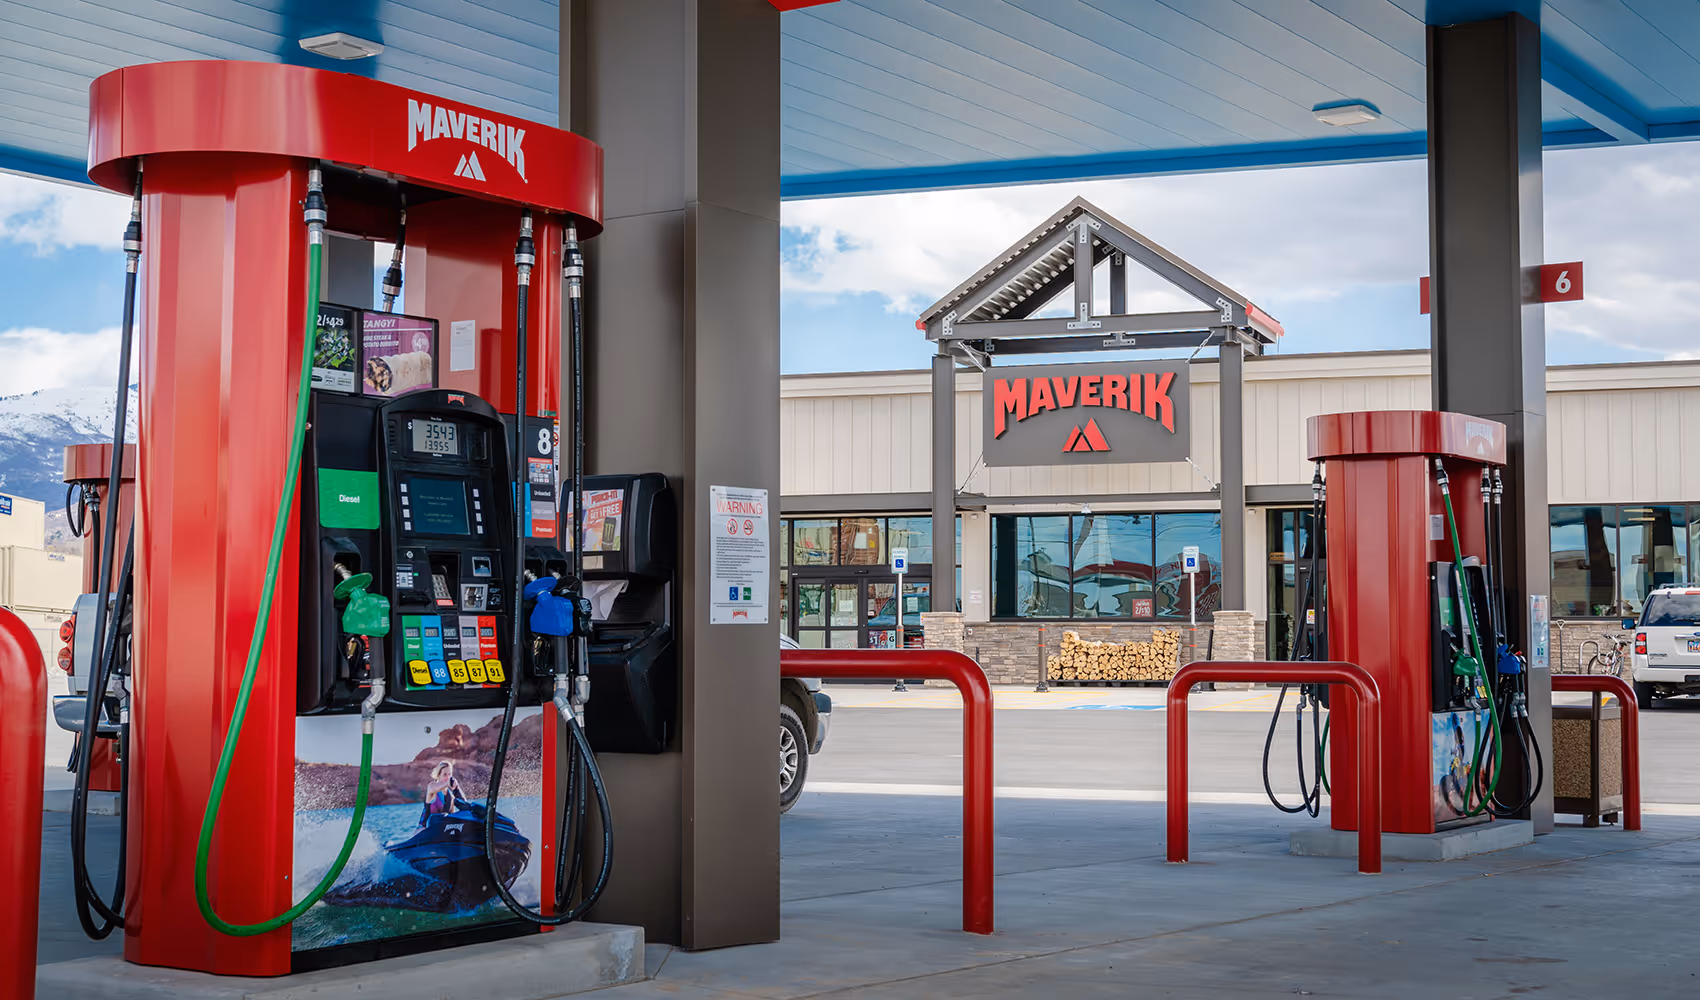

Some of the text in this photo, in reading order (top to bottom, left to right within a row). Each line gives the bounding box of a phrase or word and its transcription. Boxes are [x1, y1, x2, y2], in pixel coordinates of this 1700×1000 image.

[408, 99, 526, 181] MAVERIK
[1555, 270, 1571, 294] 6
[363, 319, 395, 329] TANGY!
[993, 372, 1177, 439] MAVERIK
[537, 428, 551, 455] 8
[339, 494, 360, 504] Diesel
[602, 503, 620, 517] FREE
[716, 498, 763, 515] WARNING
[433, 668, 446, 678] 88
[453, 668, 465, 678] 85
[471, 667, 482, 677] 87
[490, 667, 501, 677] 91
